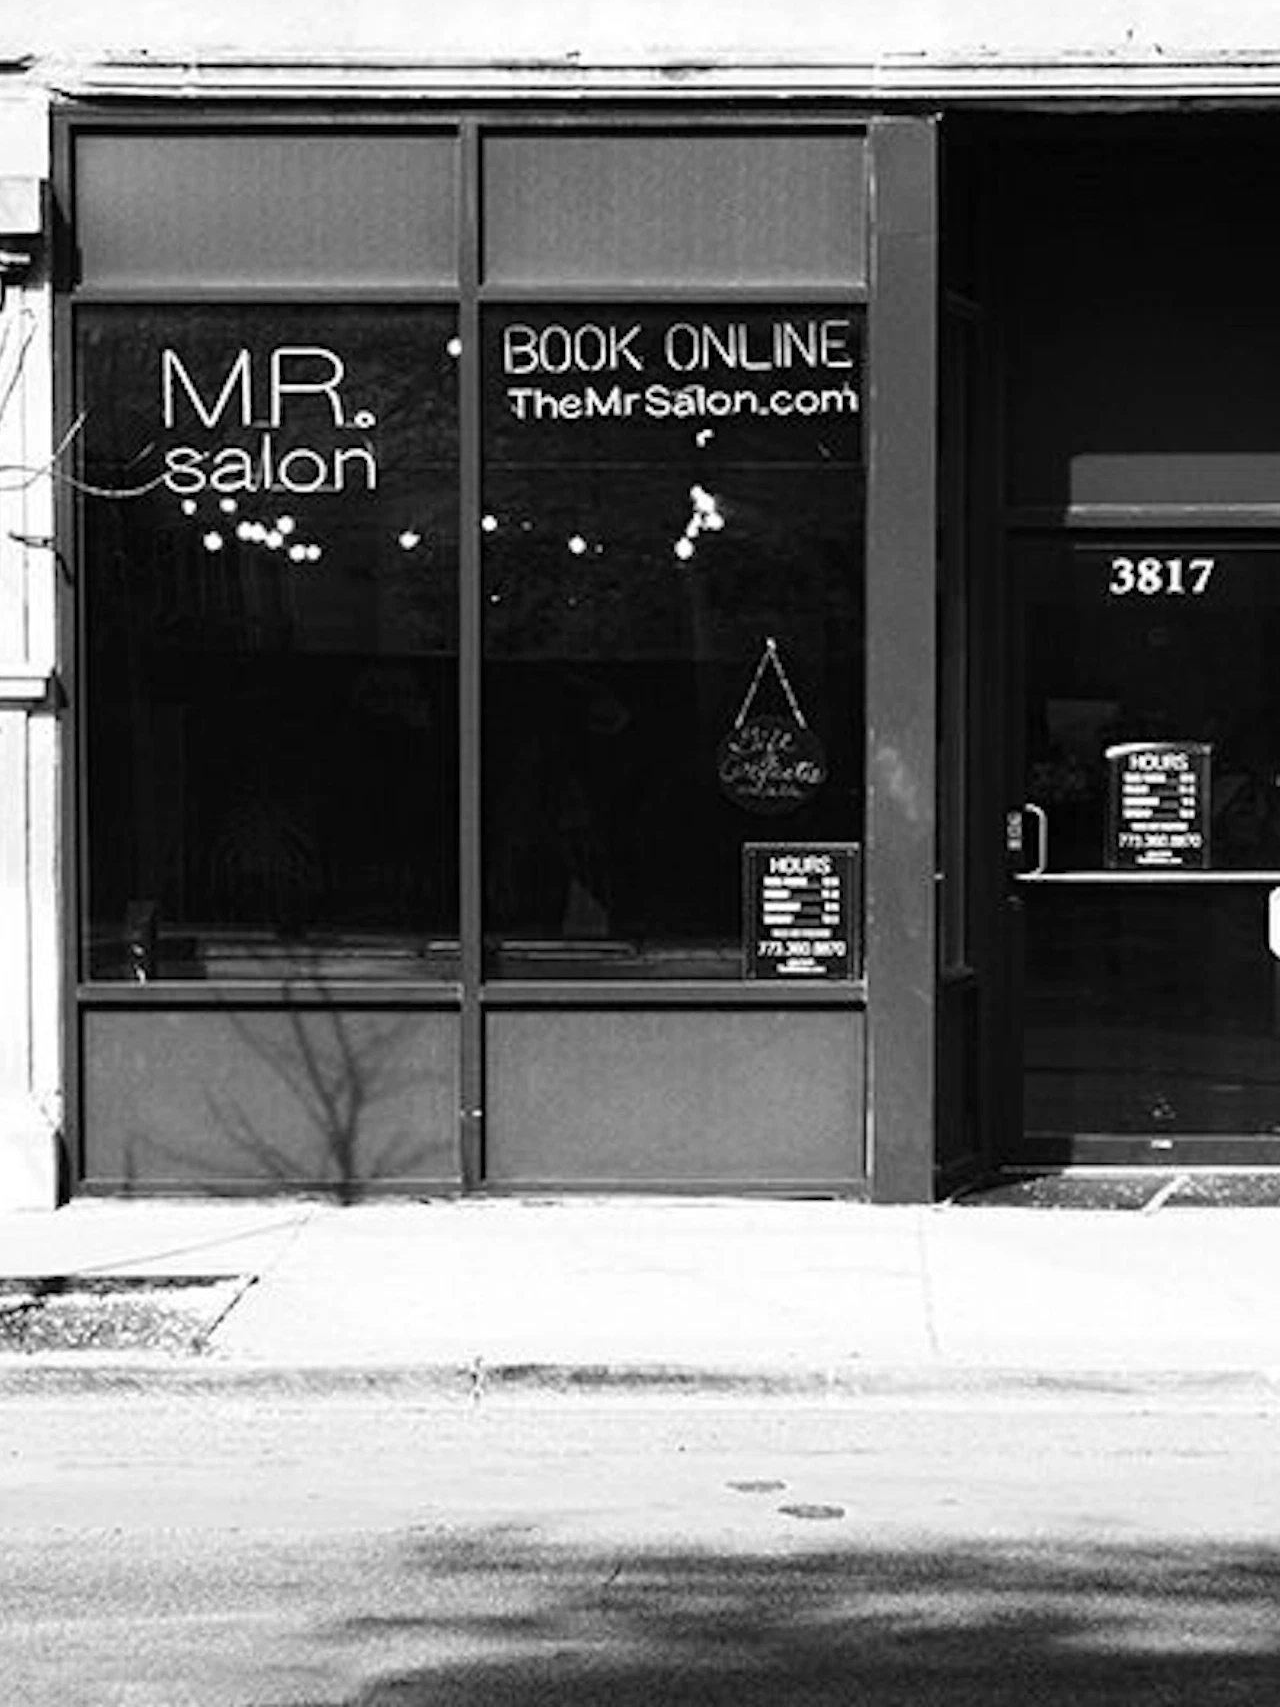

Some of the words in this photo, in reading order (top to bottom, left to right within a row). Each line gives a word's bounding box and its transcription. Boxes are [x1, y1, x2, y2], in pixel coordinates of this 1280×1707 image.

[502, 322, 645, 376] BOOK
[663, 318, 854, 372] ONLINE
[161, 346, 378, 429] MR.
[506, 382, 859, 421] TheMrSalon.com
[162, 434, 378, 494] salon
[1109, 557, 1216, 595] 3817
[1127, 752, 1190, 772] HOURS
[769, 854, 832, 876] HOURS
